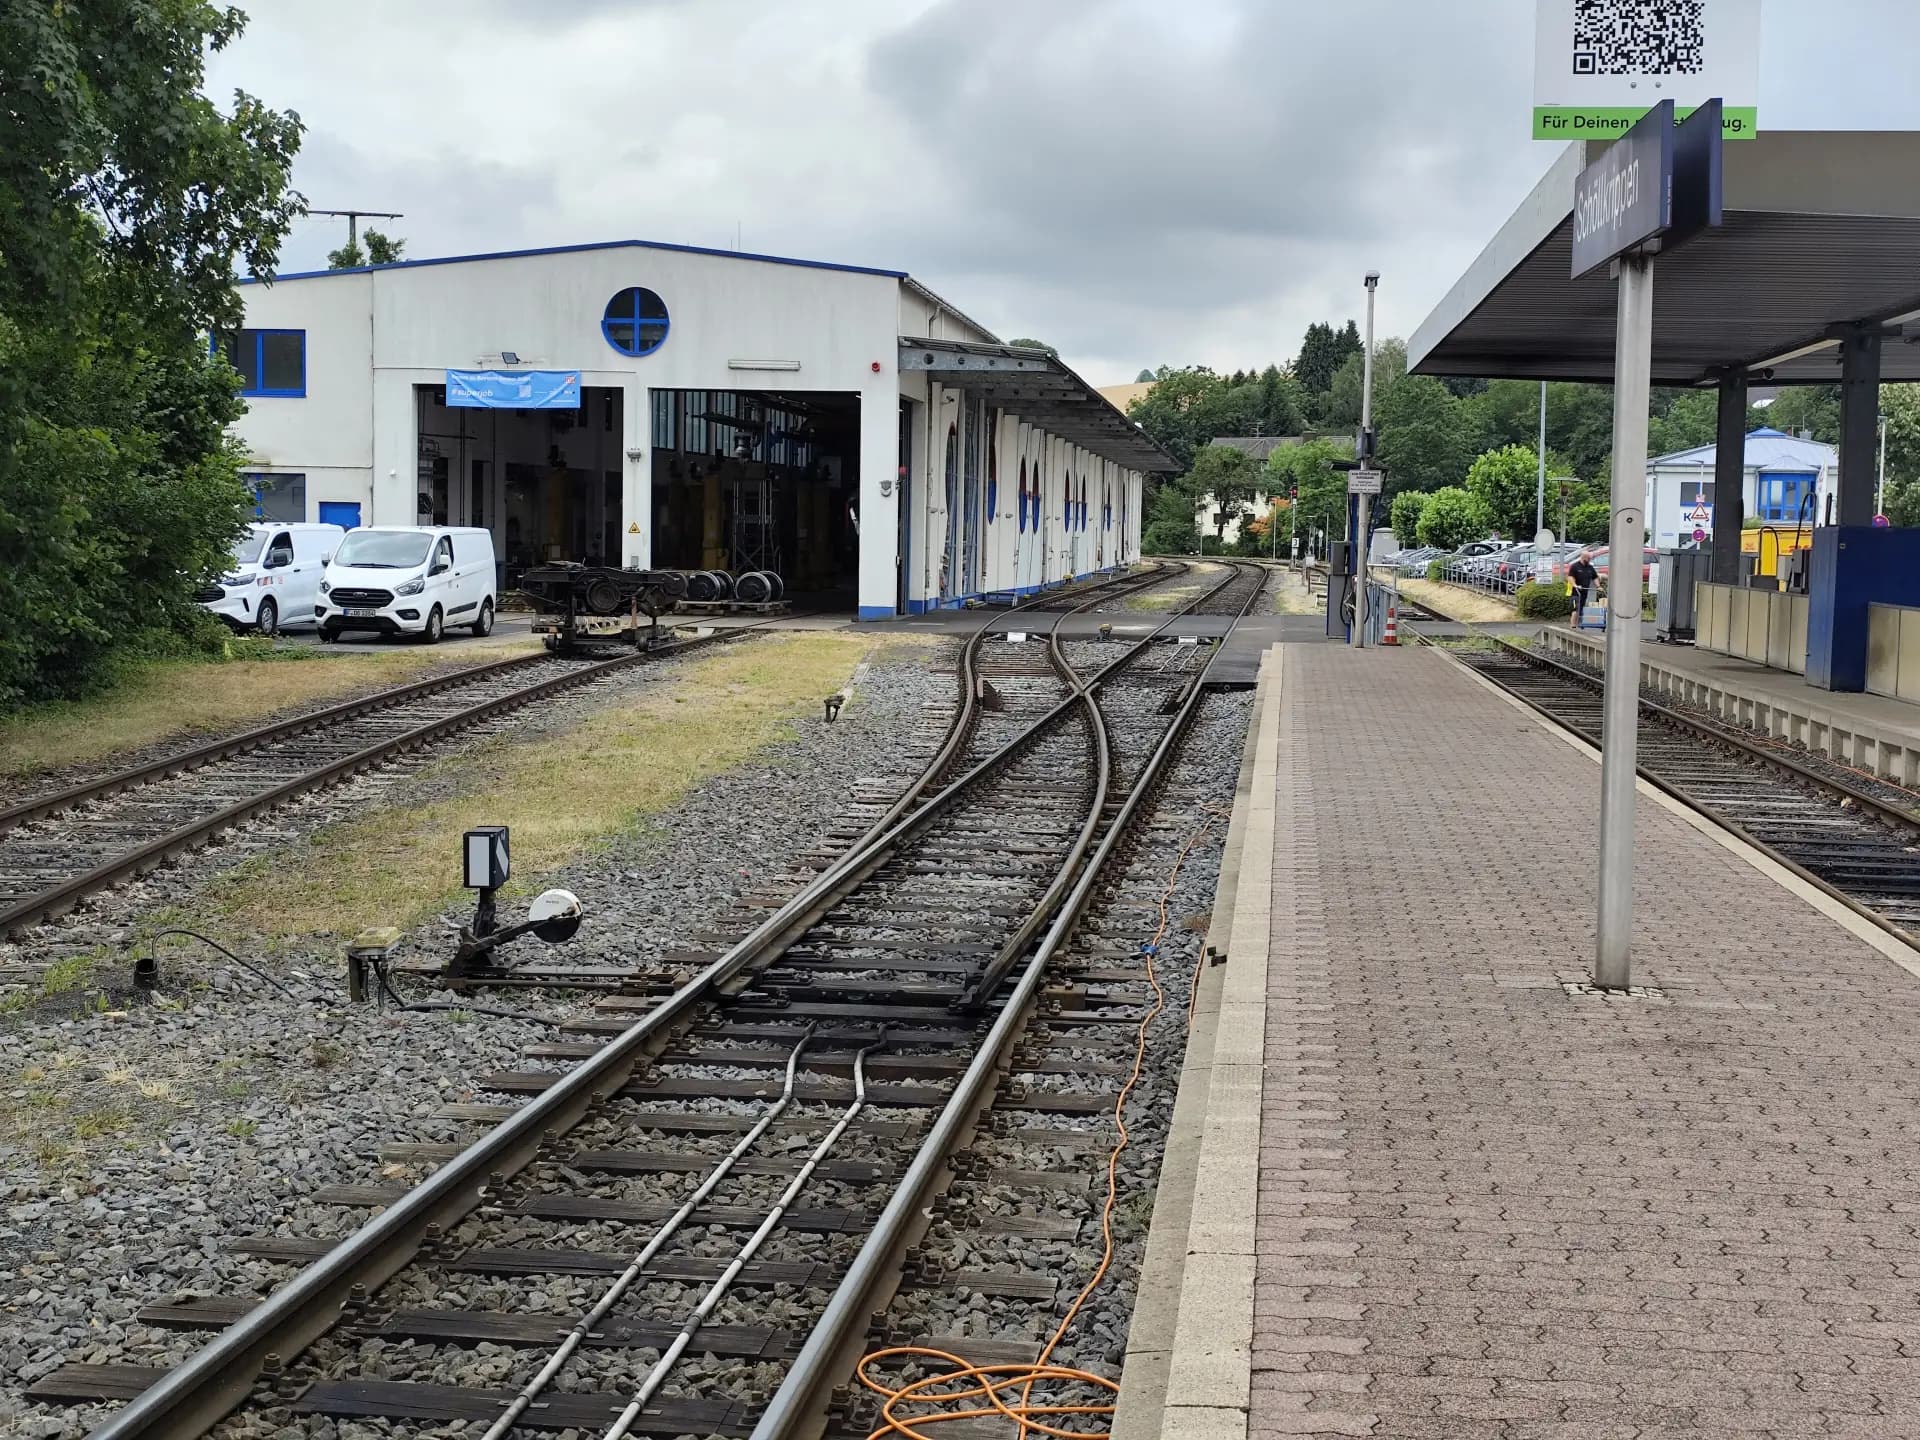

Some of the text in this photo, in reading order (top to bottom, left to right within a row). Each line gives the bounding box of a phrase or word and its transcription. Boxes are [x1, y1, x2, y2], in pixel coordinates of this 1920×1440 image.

[1542, 115, 1568, 129] Für
[1574, 115, 1629, 129] Deinen
[1722, 117, 1747, 132] ug.
[1577, 158, 1639, 243] Schöllkrippen
